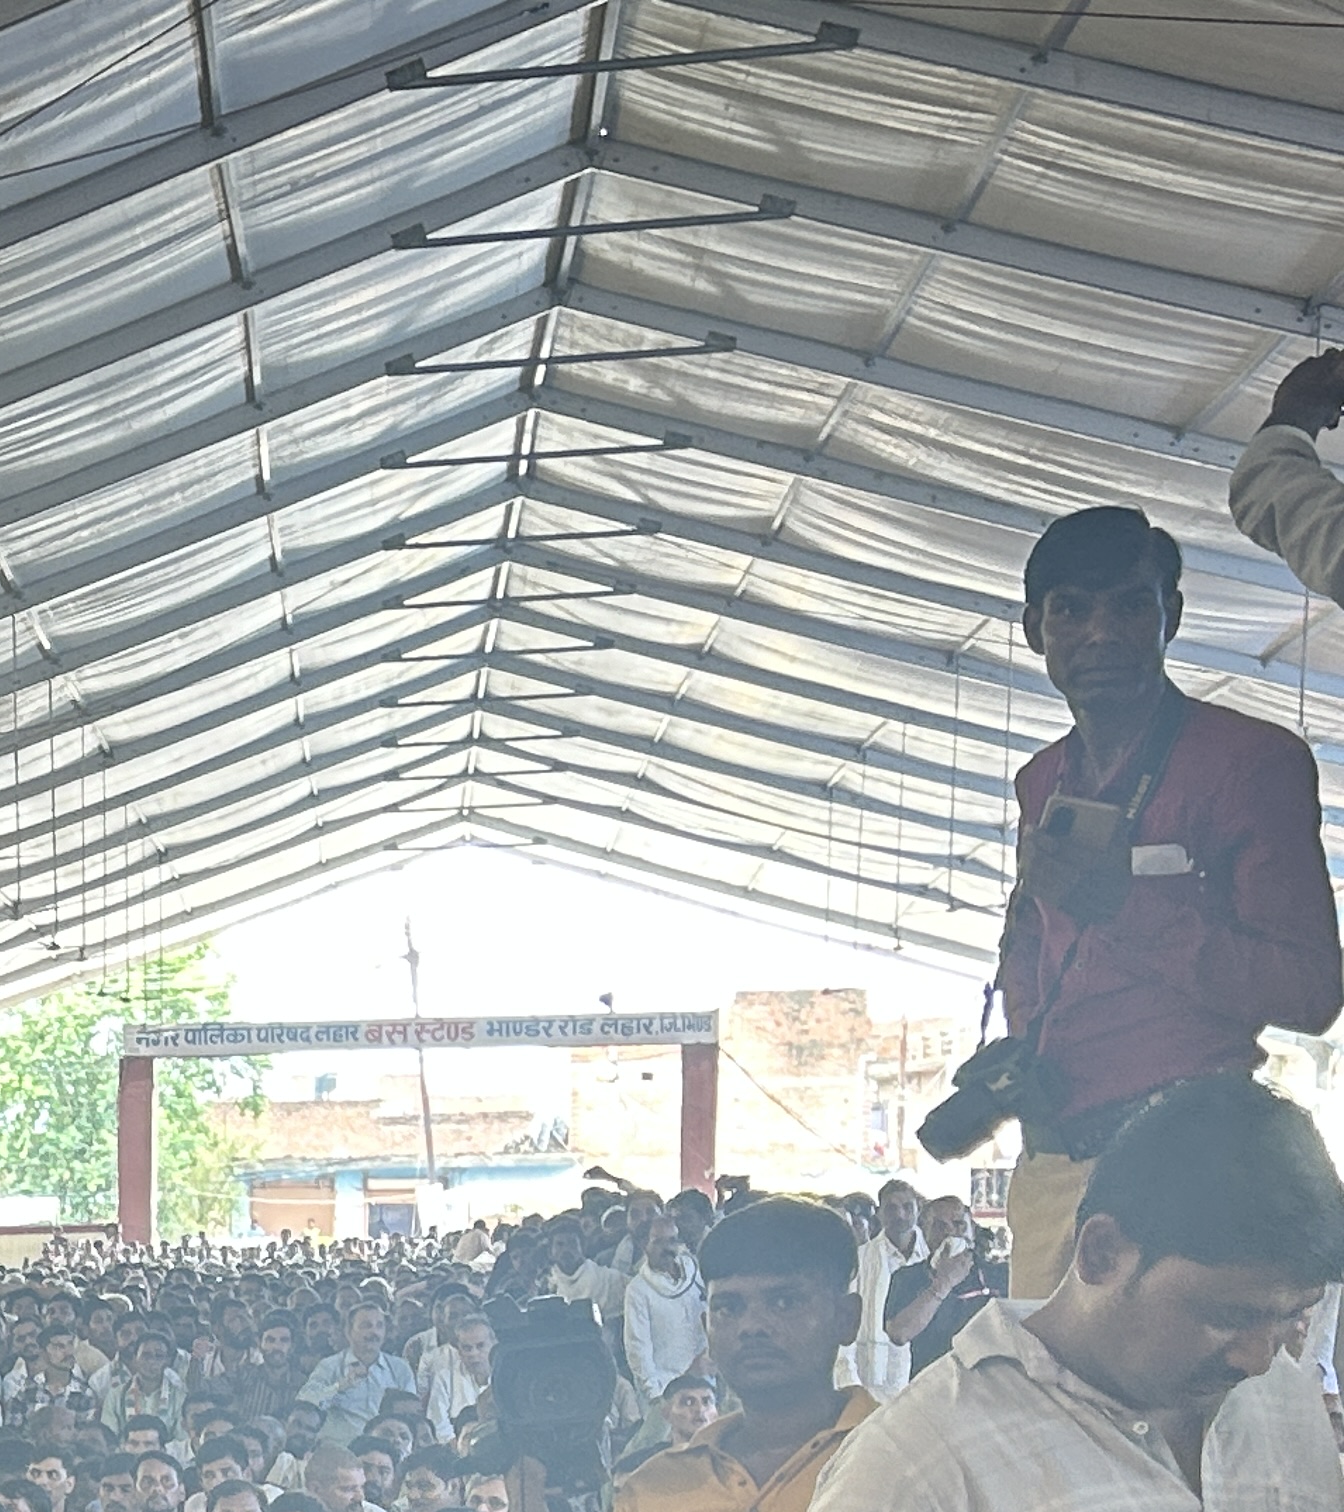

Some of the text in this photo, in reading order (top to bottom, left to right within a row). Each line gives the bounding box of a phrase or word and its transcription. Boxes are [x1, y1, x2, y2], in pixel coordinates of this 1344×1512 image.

[183, 1023, 251, 1045] पालिका
[314, 1024, 361, 1043] लहार
[364, 1022, 411, 1044] बस
